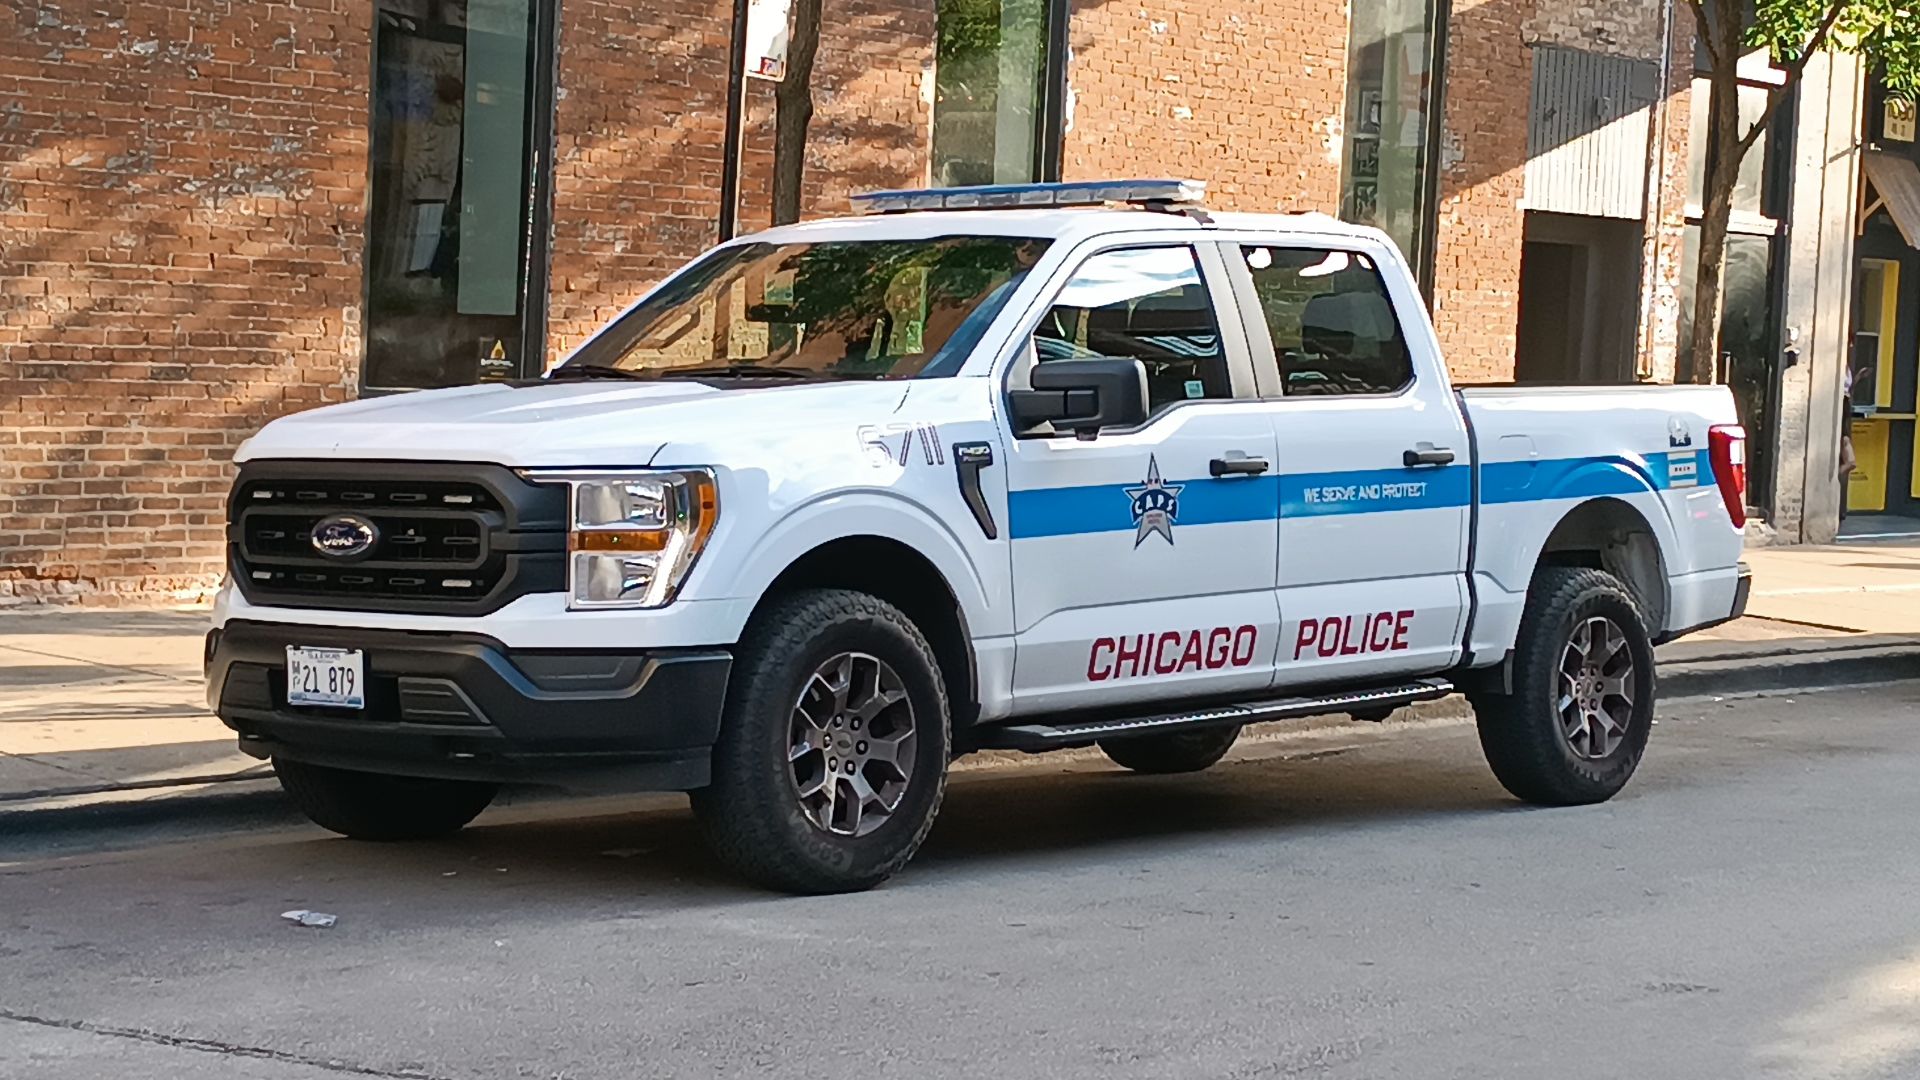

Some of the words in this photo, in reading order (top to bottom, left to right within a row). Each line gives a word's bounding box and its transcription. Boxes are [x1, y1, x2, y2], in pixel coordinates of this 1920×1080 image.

[1134, 494, 1175, 514] CAPS
[1303, 487, 1321, 503] WE
[1322, 485, 1357, 502] SERVE
[1358, 484, 1380, 500] AND
[1382, 482, 1428, 499] PROTECT
[1086, 624, 1257, 682] CHICAGO
[1293, 609, 1415, 661] POLICE
[302, 664, 321, 693] 21
[328, 666, 355, 696] 879
